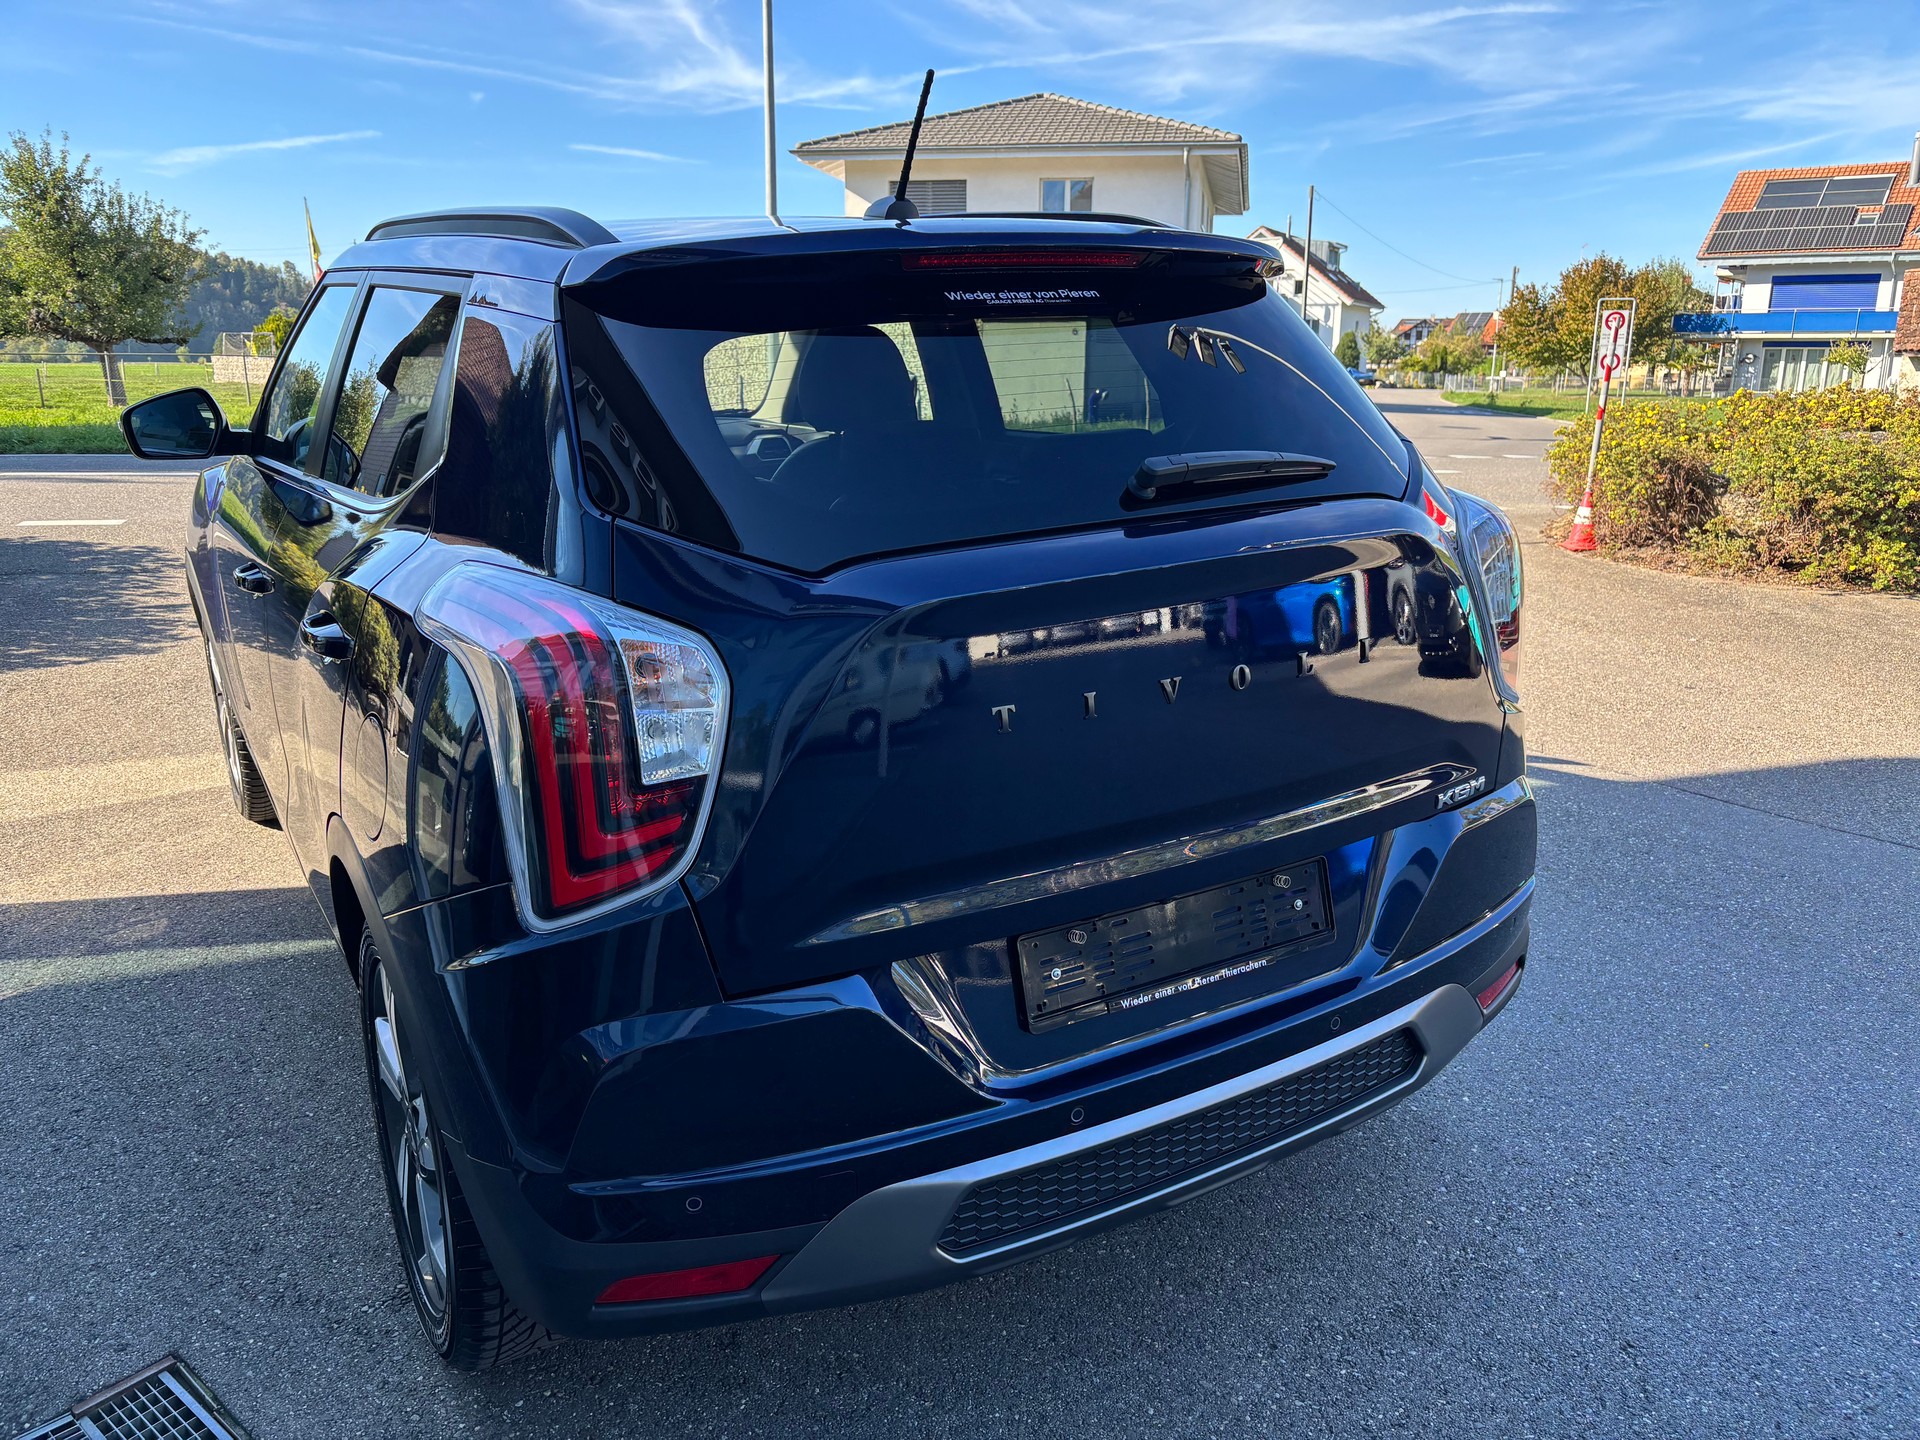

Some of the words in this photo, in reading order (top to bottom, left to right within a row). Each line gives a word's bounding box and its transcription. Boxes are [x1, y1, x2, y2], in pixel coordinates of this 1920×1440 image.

[944, 290, 996, 301] Wieder
[998, 289, 1032, 300] einer
[1033, 291, 1059, 299] von
[1058, 288, 1100, 298] Pieren
[990, 636, 1371, 734] TIVOLI
[1437, 775, 1486, 810] KGM
[1120, 992, 1153, 1009] Wieder
[1154, 987, 1176, 1000] einer
[1178, 981, 1193, 992] von
[1194, 974, 1220, 988] Pieren
[1220, 959, 1268, 979] Thierachern
